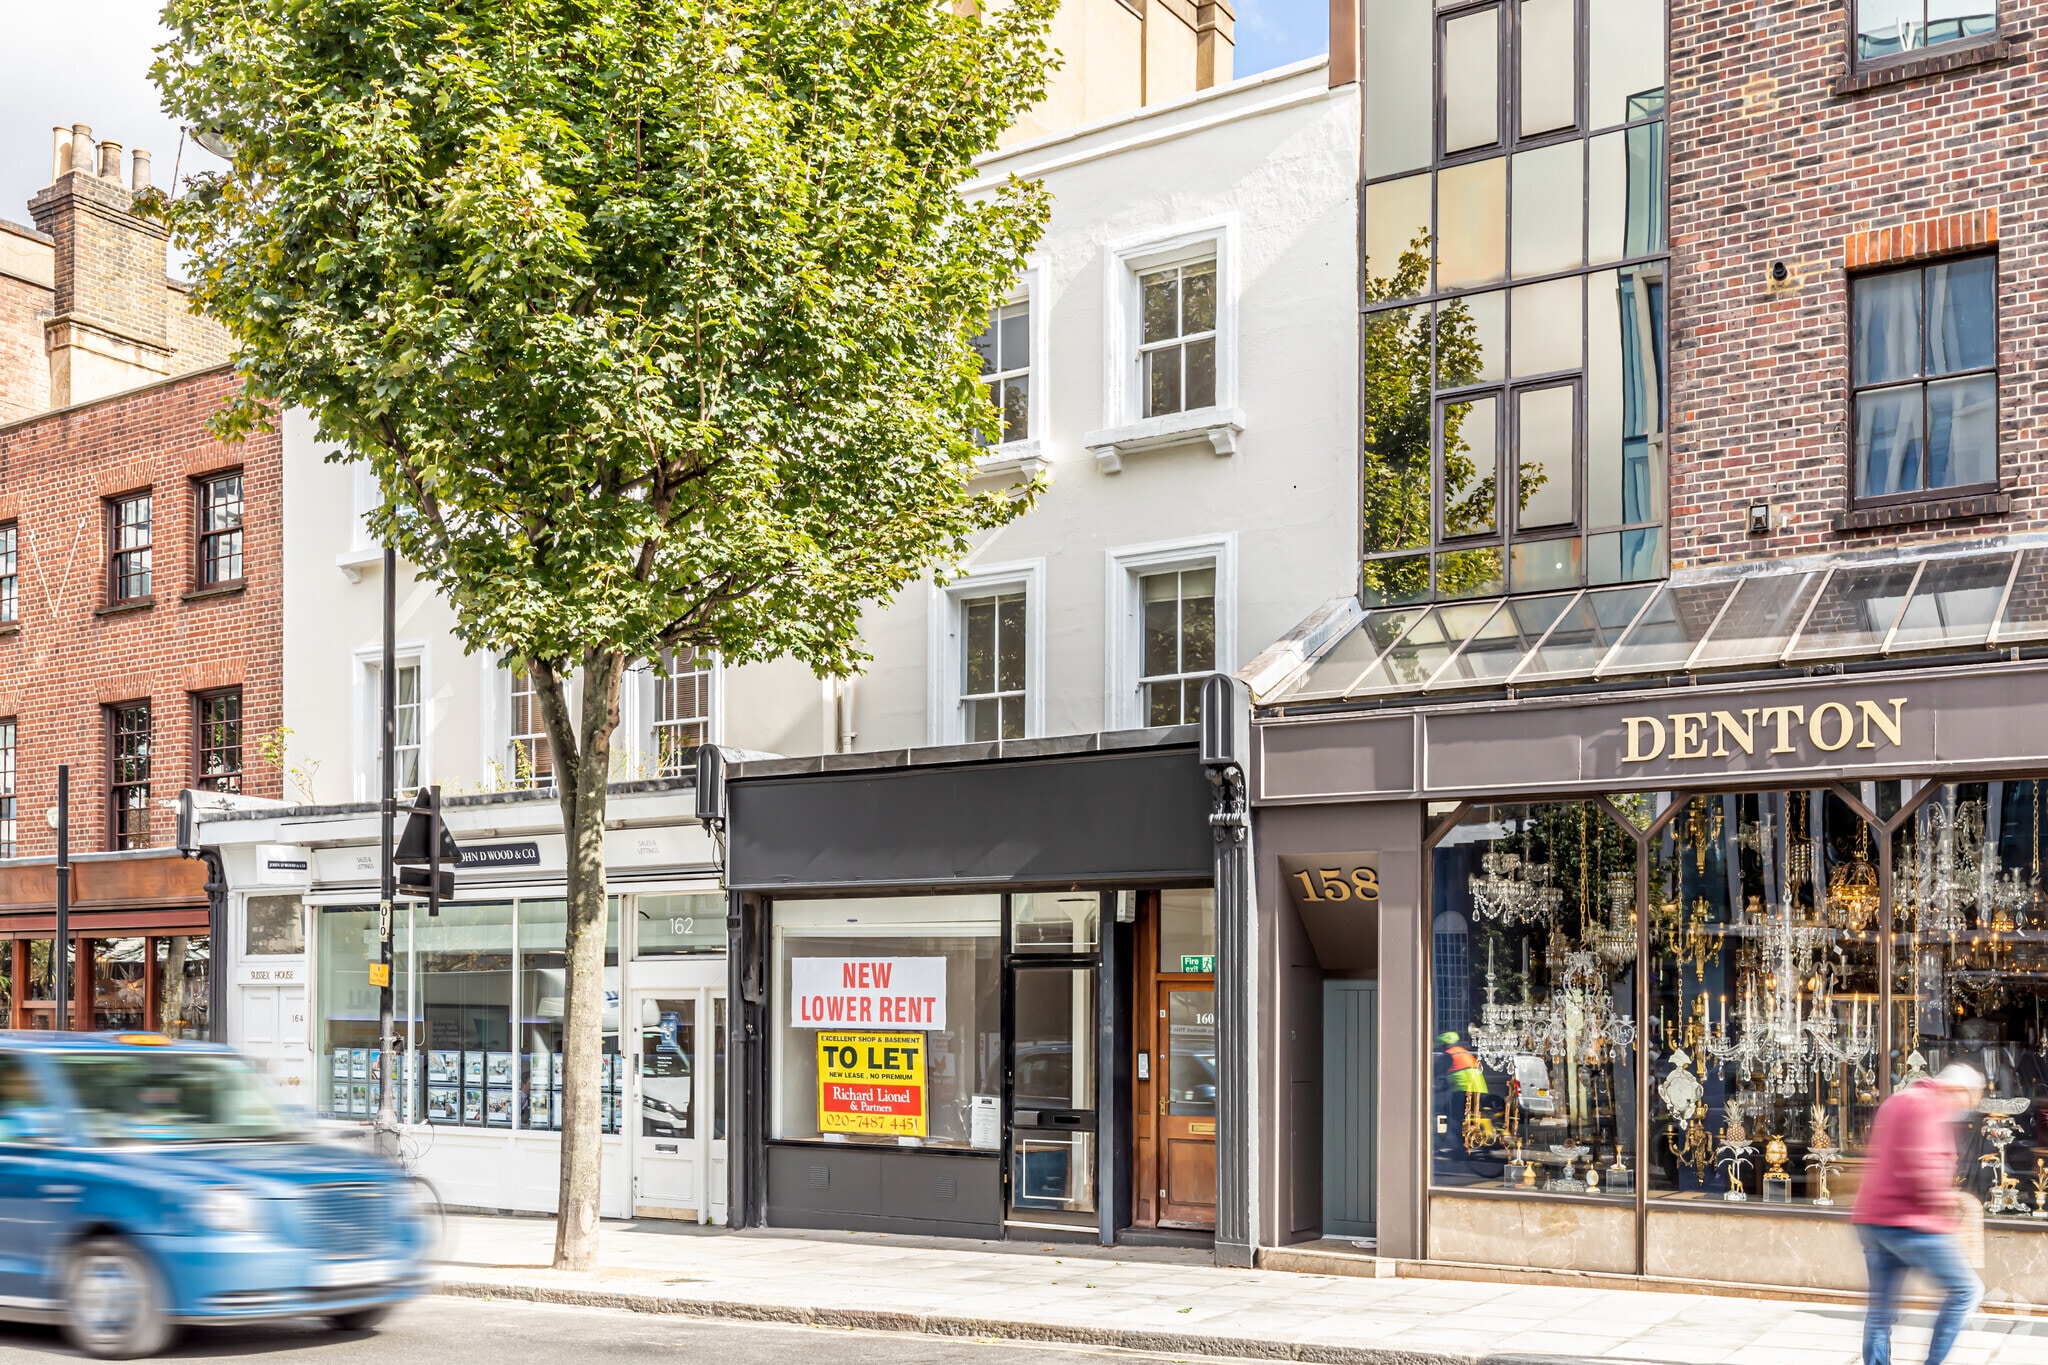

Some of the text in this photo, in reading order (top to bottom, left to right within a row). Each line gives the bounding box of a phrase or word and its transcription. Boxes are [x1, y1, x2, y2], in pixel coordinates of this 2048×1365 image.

[1621, 698, 1907, 762] DENTON
[480, 851, 487, 861] D
[487, 849, 513, 861] WOOD
[514, 850, 521, 859] &
[1293, 866, 1379, 901] 158
[669, 917, 693, 934] 162
[1184, 957, 1199, 965] Fire
[251, 971, 294, 980] SUSSEX HOUSE
[843, 962, 892, 988] NEW
[801, 995, 936, 1023] LOWER RENT
[292, 1014, 304, 1022] 164
[1196, 1013, 1214, 1024] 160
[823, 1046, 919, 1070] TO LET
[833, 1086, 910, 1103] Richard Lionel
[850, 1101, 892, 1113] & Partners
[826, 1114, 885, 1129] 020-7487
